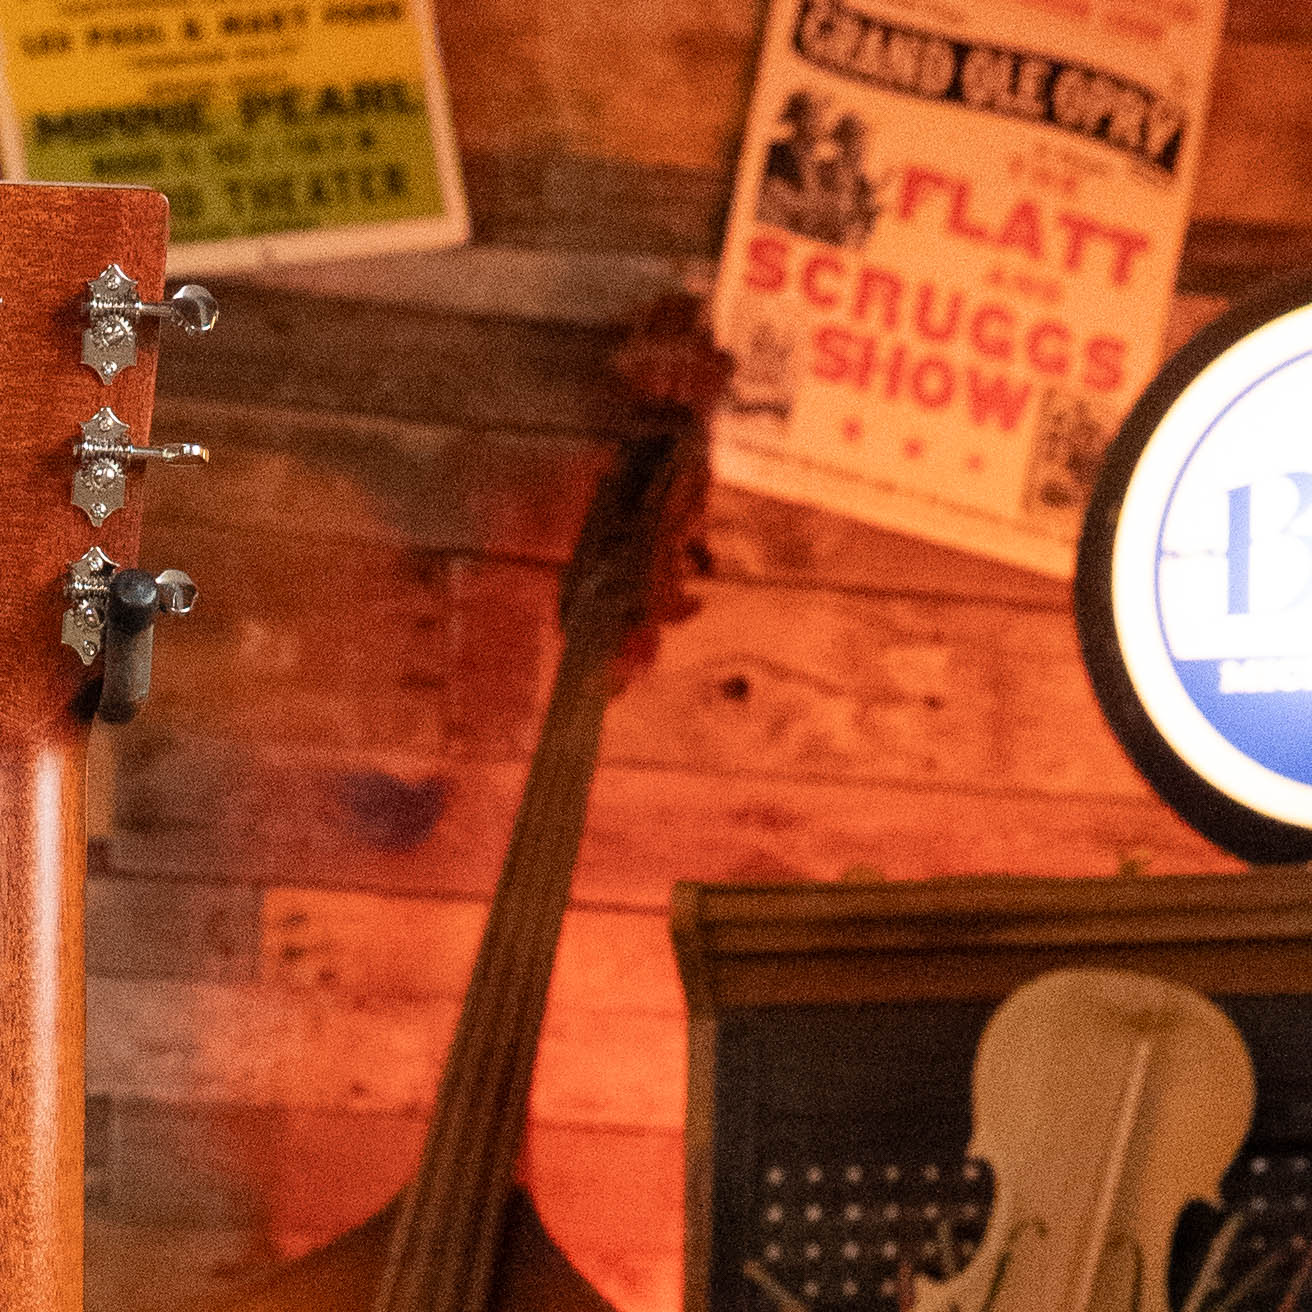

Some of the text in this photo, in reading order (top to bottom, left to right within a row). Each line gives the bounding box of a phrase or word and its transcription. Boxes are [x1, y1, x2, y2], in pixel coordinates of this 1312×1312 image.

[798, 8, 956, 96] GRAND
[961, 46, 1050, 108] OLE
[898, 165, 1152, 288] FLATT
[743, 235, 1130, 396] SCRUGGS
[810, 326, 1032, 434] SHOW
